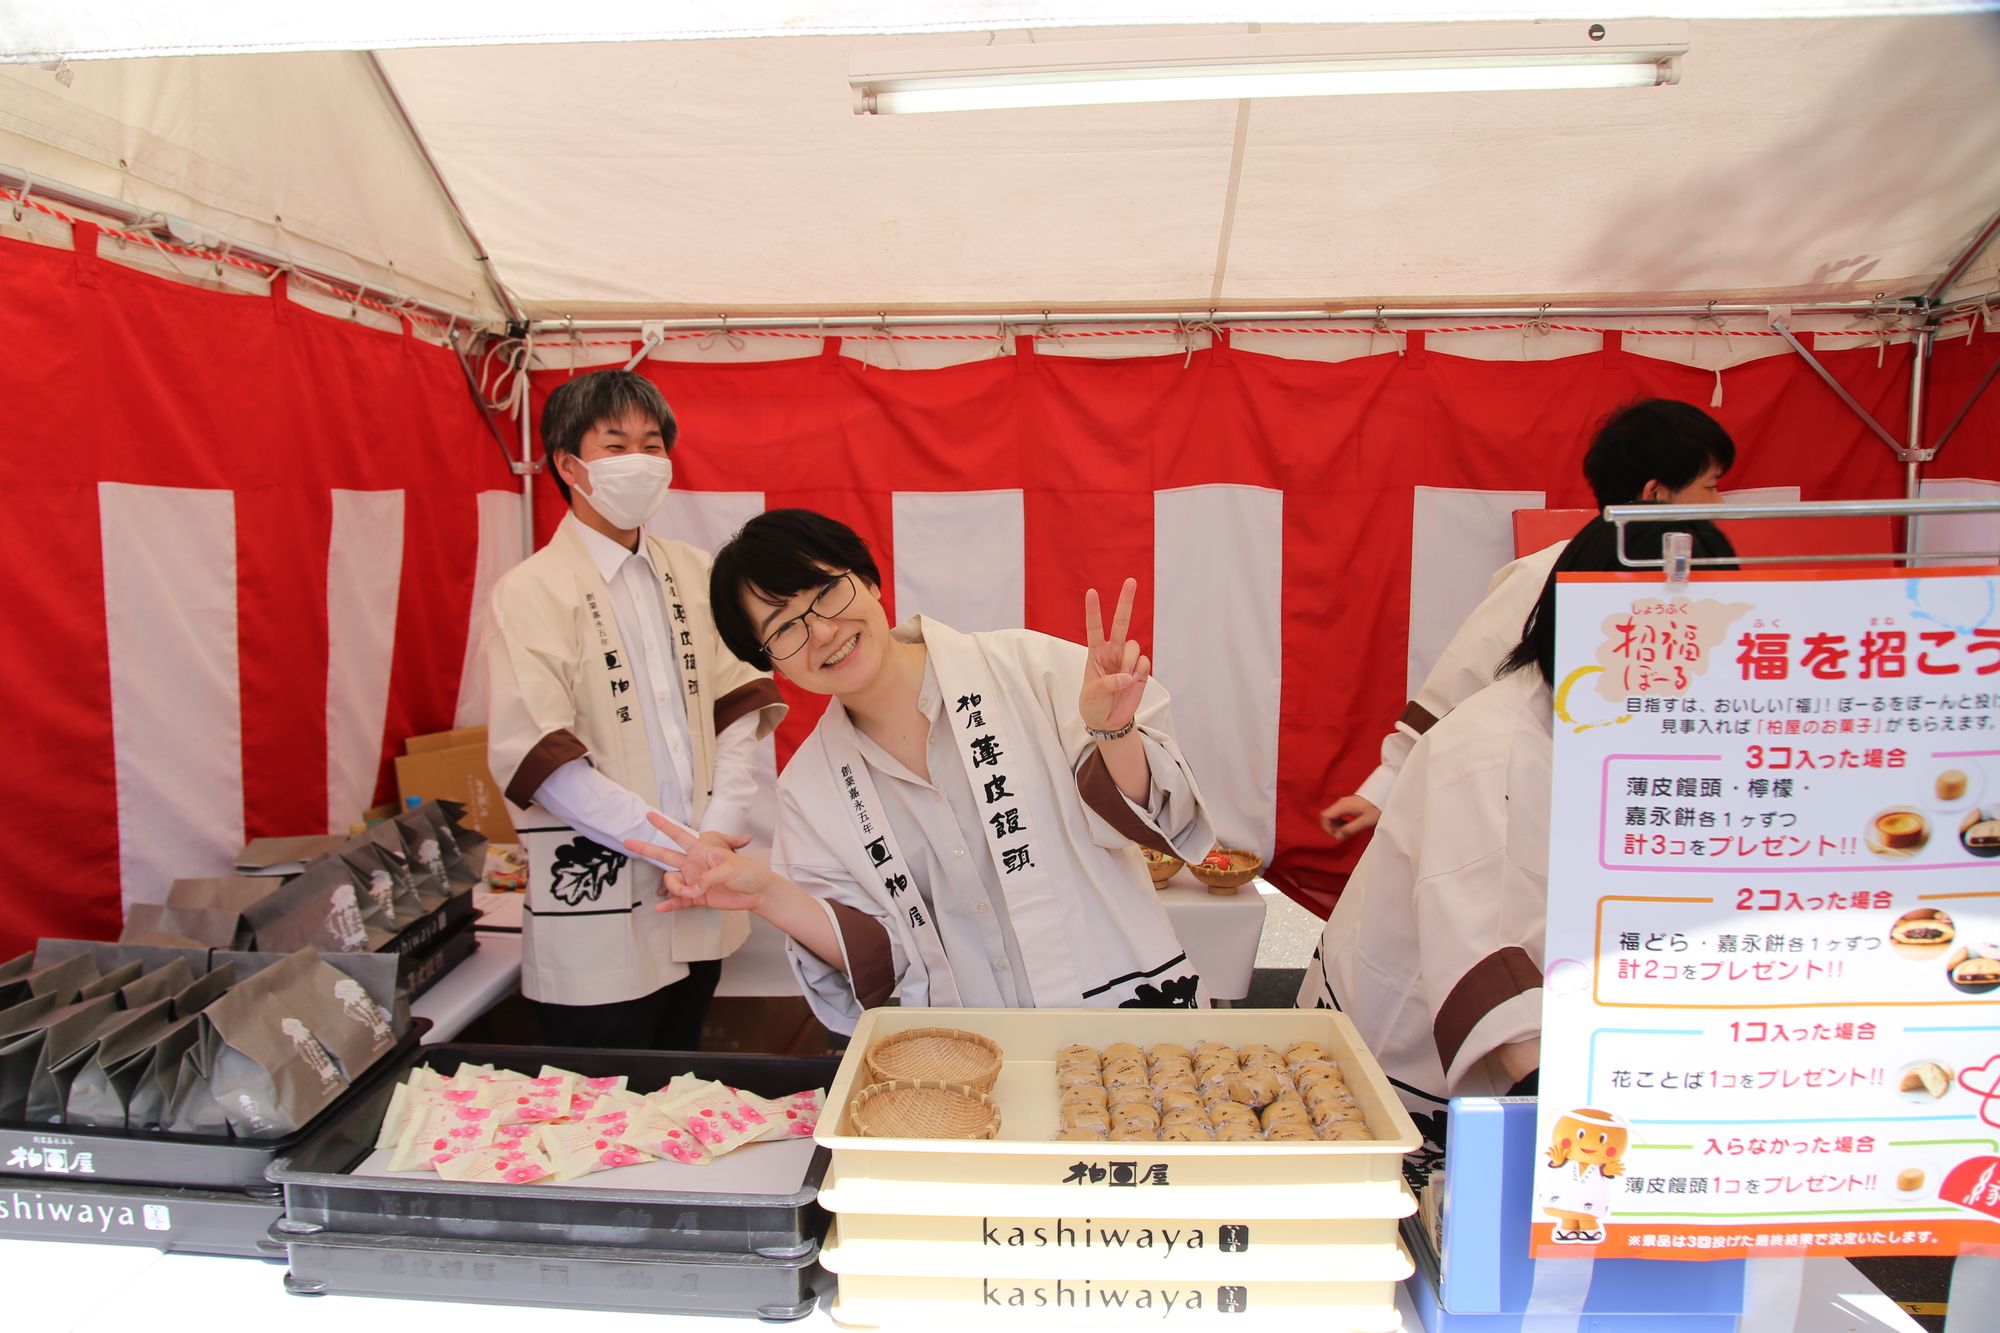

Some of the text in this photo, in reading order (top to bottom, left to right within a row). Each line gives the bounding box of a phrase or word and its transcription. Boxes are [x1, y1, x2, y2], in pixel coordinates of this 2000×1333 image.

[1631, 603, 1689, 615] しょうふく
[1753, 618, 1781, 628] ふく
[1613, 615, 1699, 662] 招福
[1746, 745, 1908, 770] 3コ入った場合
[956, 693, 1035, 875] 柏屋 薄皮饅頭
[841, 763, 926, 929] 創業嘉永五年 柏屋
[1624, 833, 1858, 858] 計3コをプレゼント!!
[1736, 887, 1894, 912] 2コ入った場合
[1618, 959, 1844, 981] 計2コをプレゼント!!
[1730, 1021, 1877, 1043] 1コ入った場合
[1611, 1067, 1885, 1090] 花ことば1コをプレゼント!!
[1703, 1136, 1876, 1156] 入らなかった場合
[7, 1146, 96, 1173] 柏屋
[1062, 1161, 1170, 1187] 柏屋
[1624, 1174, 1878, 1195] 薄皮饅頭1コをプレゼント!!
[982, 1217, 1204, 1259] kashiwaya
[982, 1278, 1203, 1319] kashiwaya
